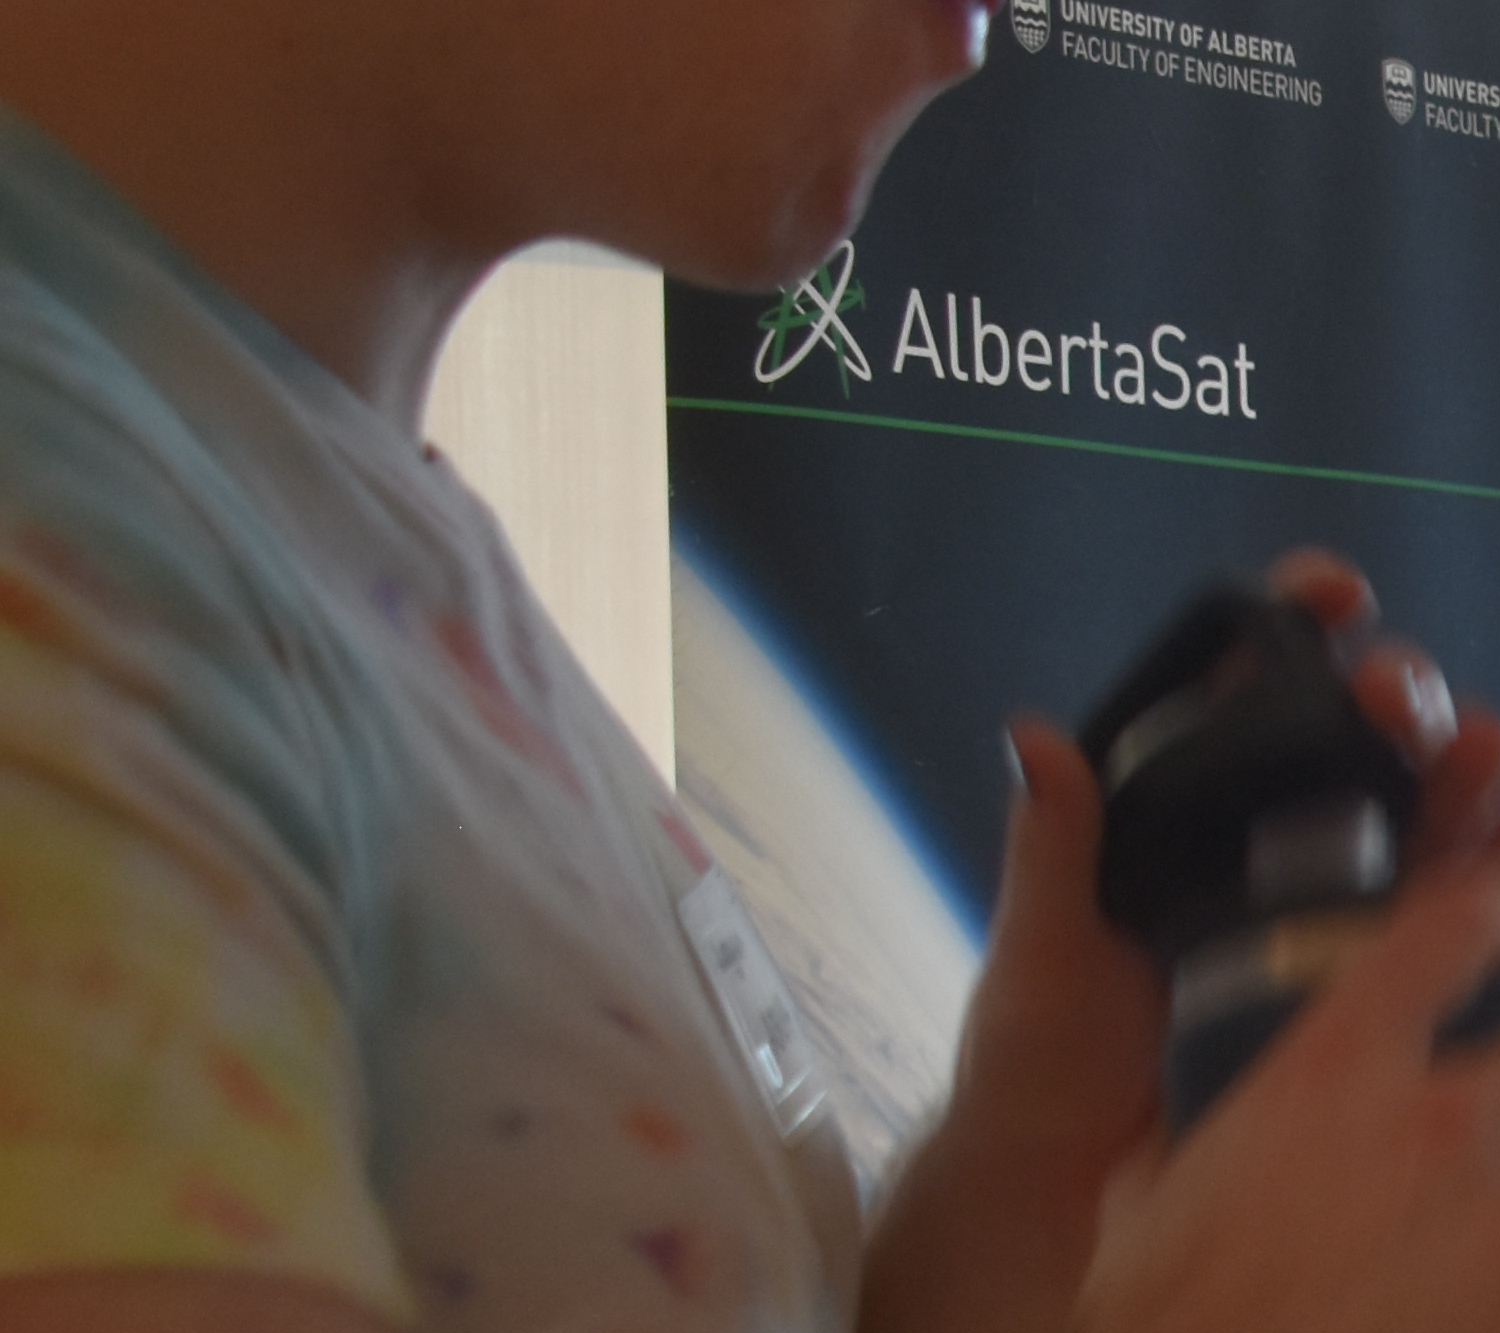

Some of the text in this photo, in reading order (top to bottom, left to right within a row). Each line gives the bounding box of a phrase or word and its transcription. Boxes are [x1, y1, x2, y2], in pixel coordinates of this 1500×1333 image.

[1060, 0, 1297, 68] UNIVERSITY OF ALBERTA
[1061, 30, 1323, 107] FACULTY OF ENGINEERING
[892, 287, 1257, 420] AlbertaSat
